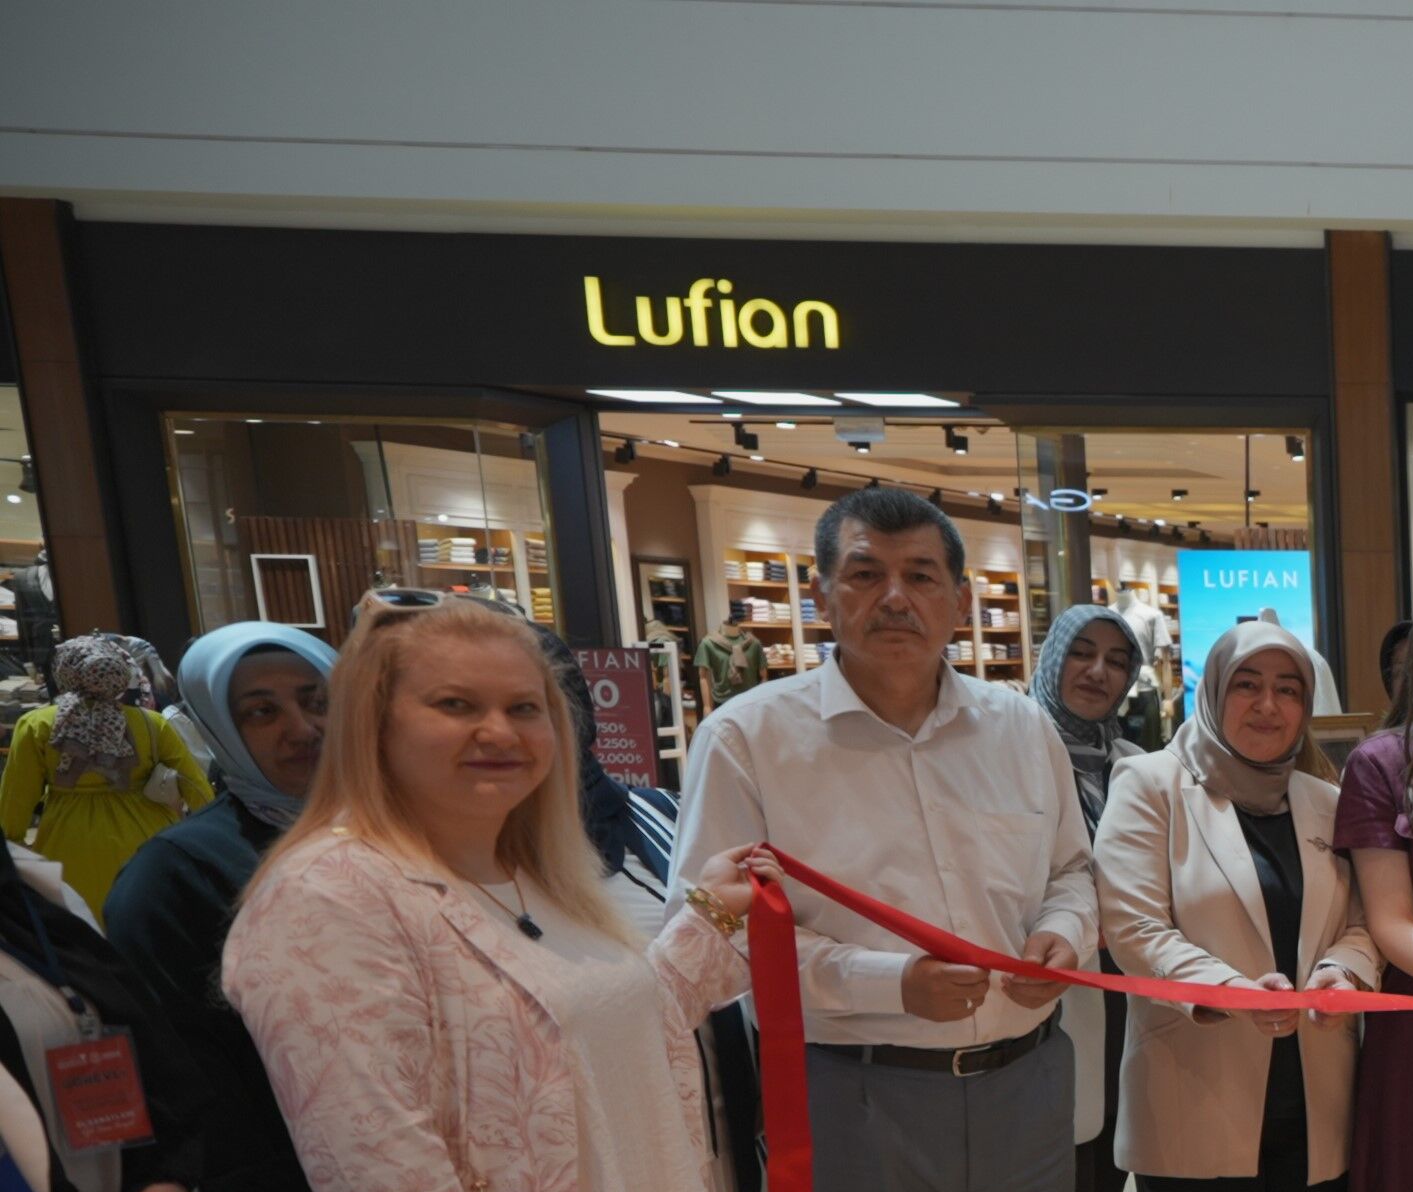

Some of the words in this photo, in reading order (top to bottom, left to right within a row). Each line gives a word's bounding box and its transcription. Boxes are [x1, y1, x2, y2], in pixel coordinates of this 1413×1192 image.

[583, 275, 839, 349] Lufian
[1203, 569, 1298, 588] LUFIAN
[577, 651, 640, 669] FIAN
